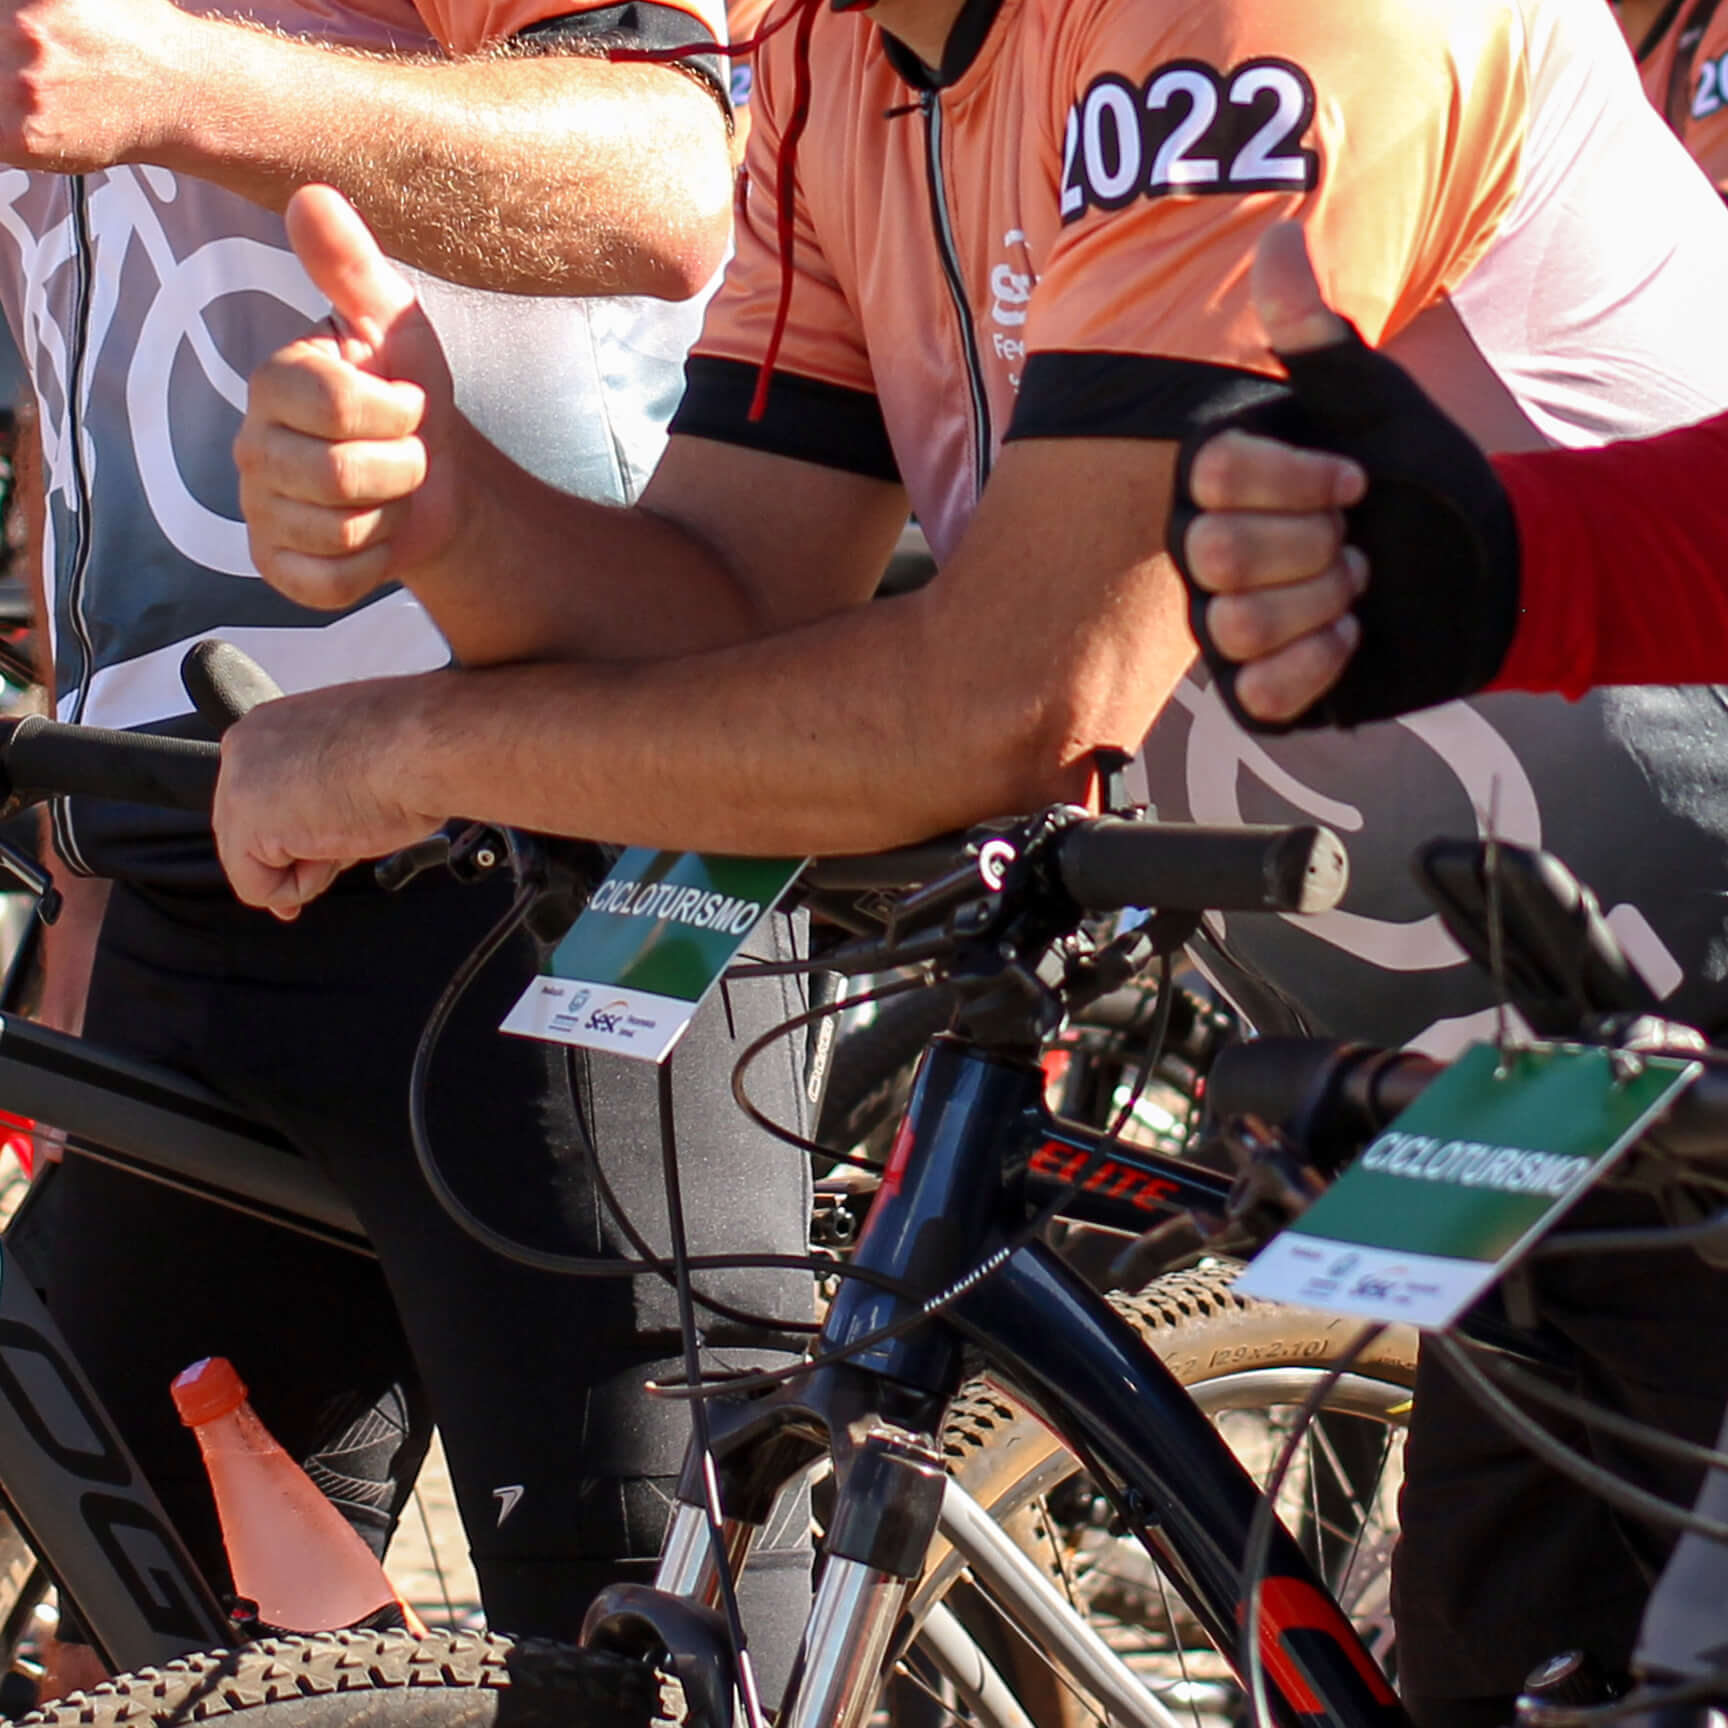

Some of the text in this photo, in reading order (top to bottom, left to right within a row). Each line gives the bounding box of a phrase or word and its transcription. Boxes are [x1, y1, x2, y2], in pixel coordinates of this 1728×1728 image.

[590, 880, 760, 935] CICLOTURISMO
[1027, 1138, 1181, 1212] ELITE
[1362, 1131, 1592, 1197] CICLOTURISMO
